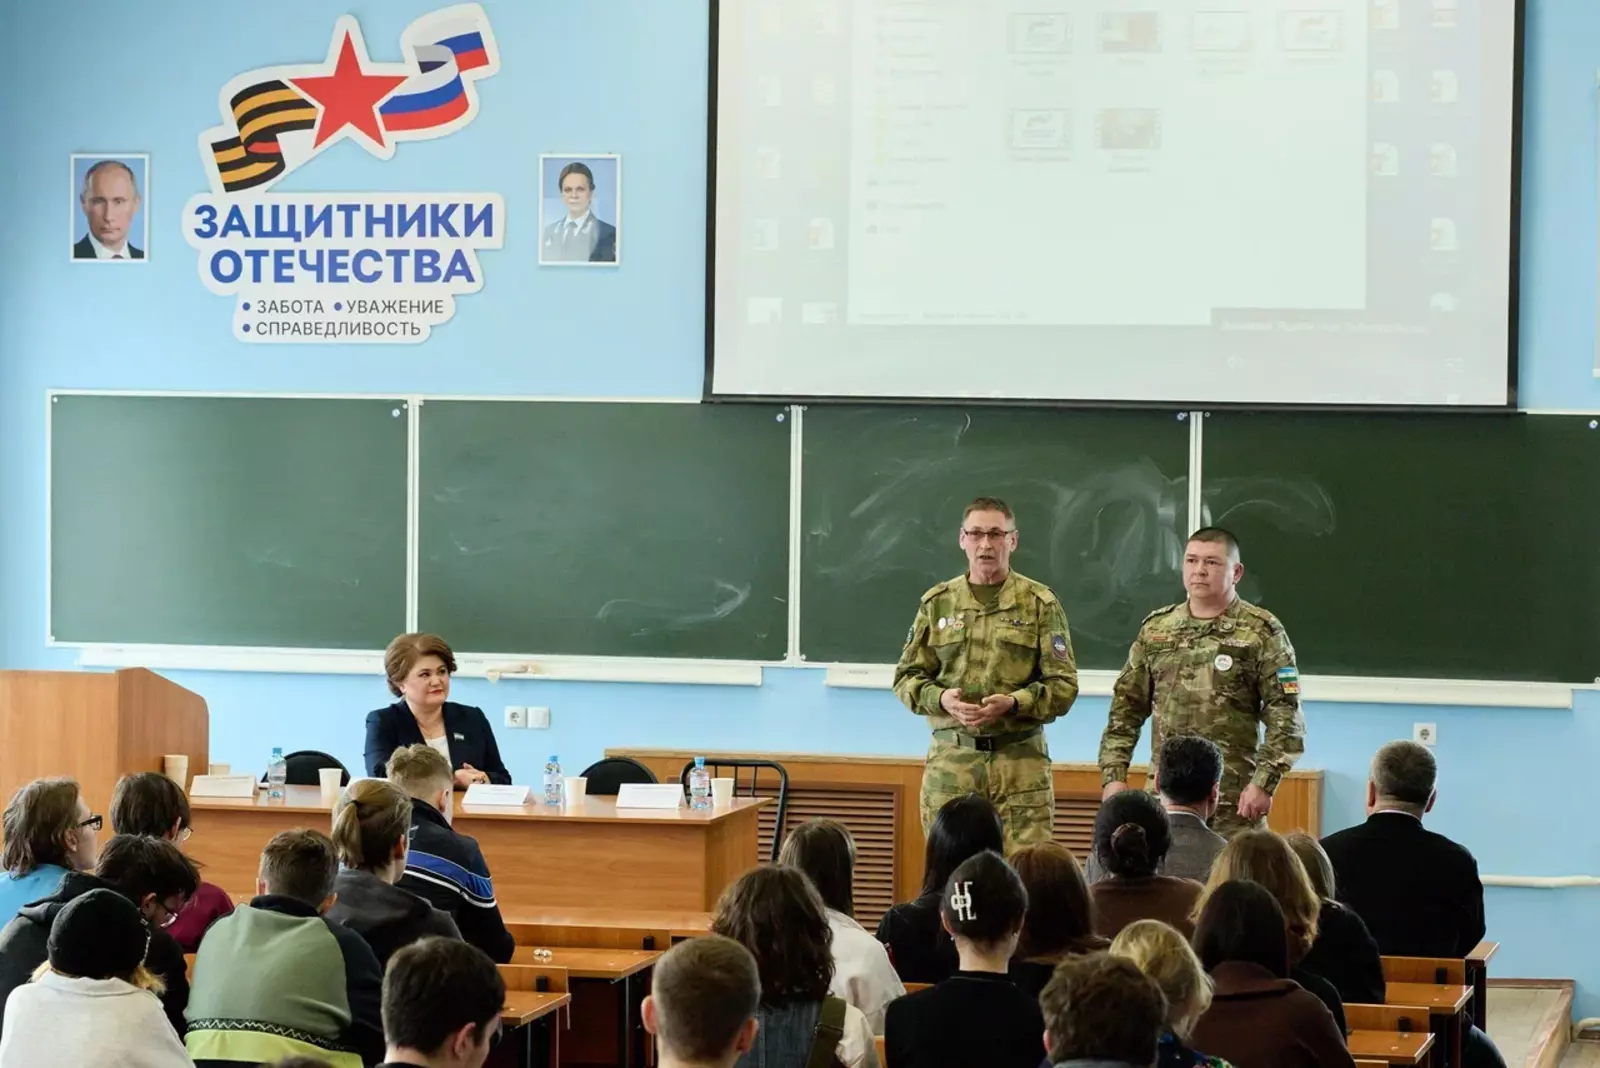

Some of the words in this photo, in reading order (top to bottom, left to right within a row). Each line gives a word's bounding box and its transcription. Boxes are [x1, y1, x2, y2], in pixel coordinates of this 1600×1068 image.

[194, 204, 492, 242] ЗАЩИТНИКИ
[211, 249, 475, 283] ОТЕЧЕСТВА
[258, 300, 324, 313] ЗАБОТА
[347, 300, 442, 313] УВАЖЕНИЕ
[257, 322, 420, 337] СПРАВЕДЛИВОСТЬ
